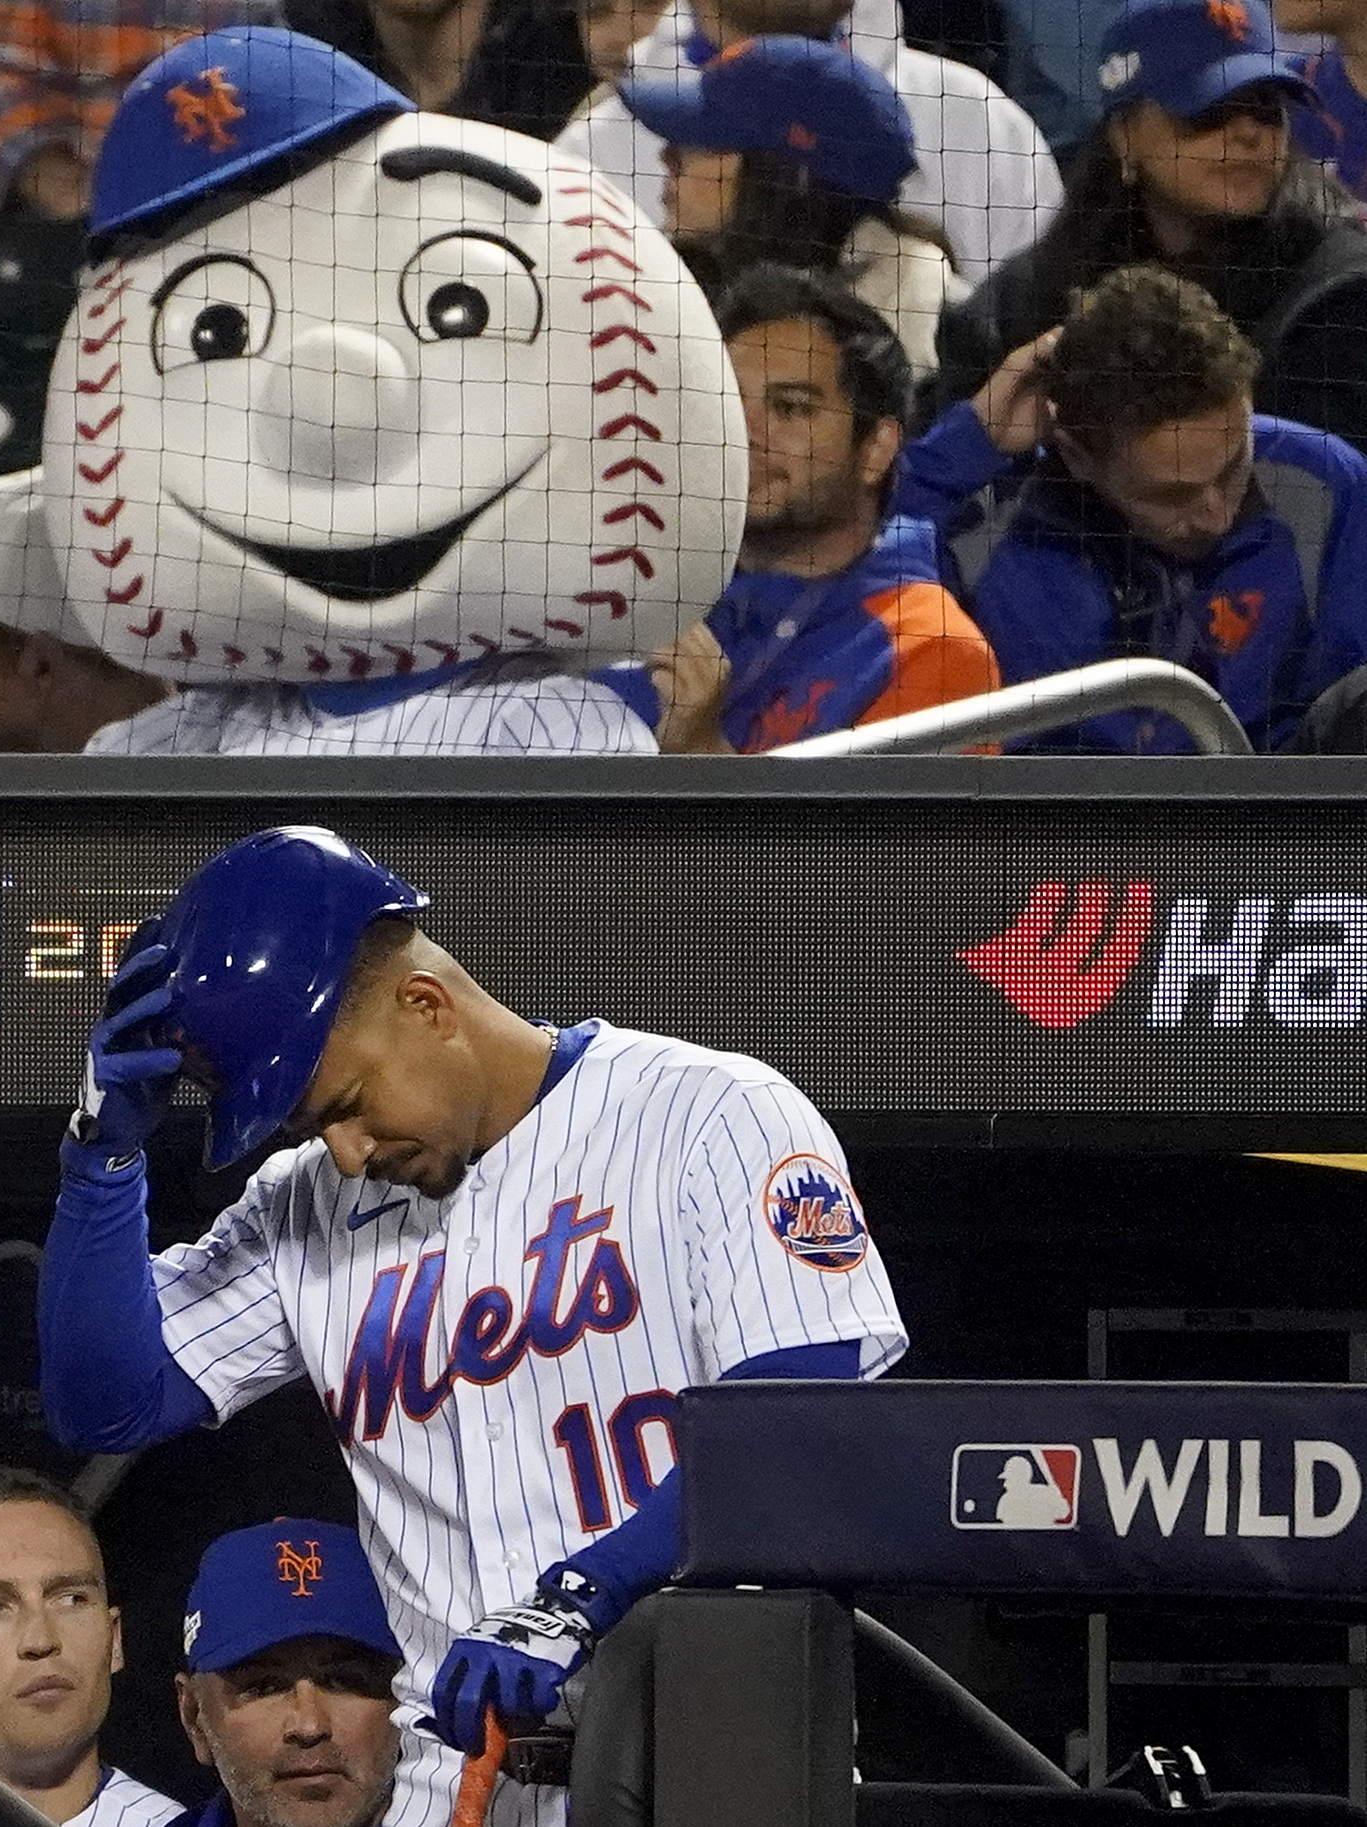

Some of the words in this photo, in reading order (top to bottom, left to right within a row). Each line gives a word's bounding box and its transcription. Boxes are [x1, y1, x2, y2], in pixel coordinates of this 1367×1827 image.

[1146, 891, 1367, 1027] Ha
[324, 1193, 639, 1451] Mets
[553, 1388, 678, 1534] 10
[1092, 1437, 1363, 1538] WILD
[275, 1540, 323, 1596] NY
